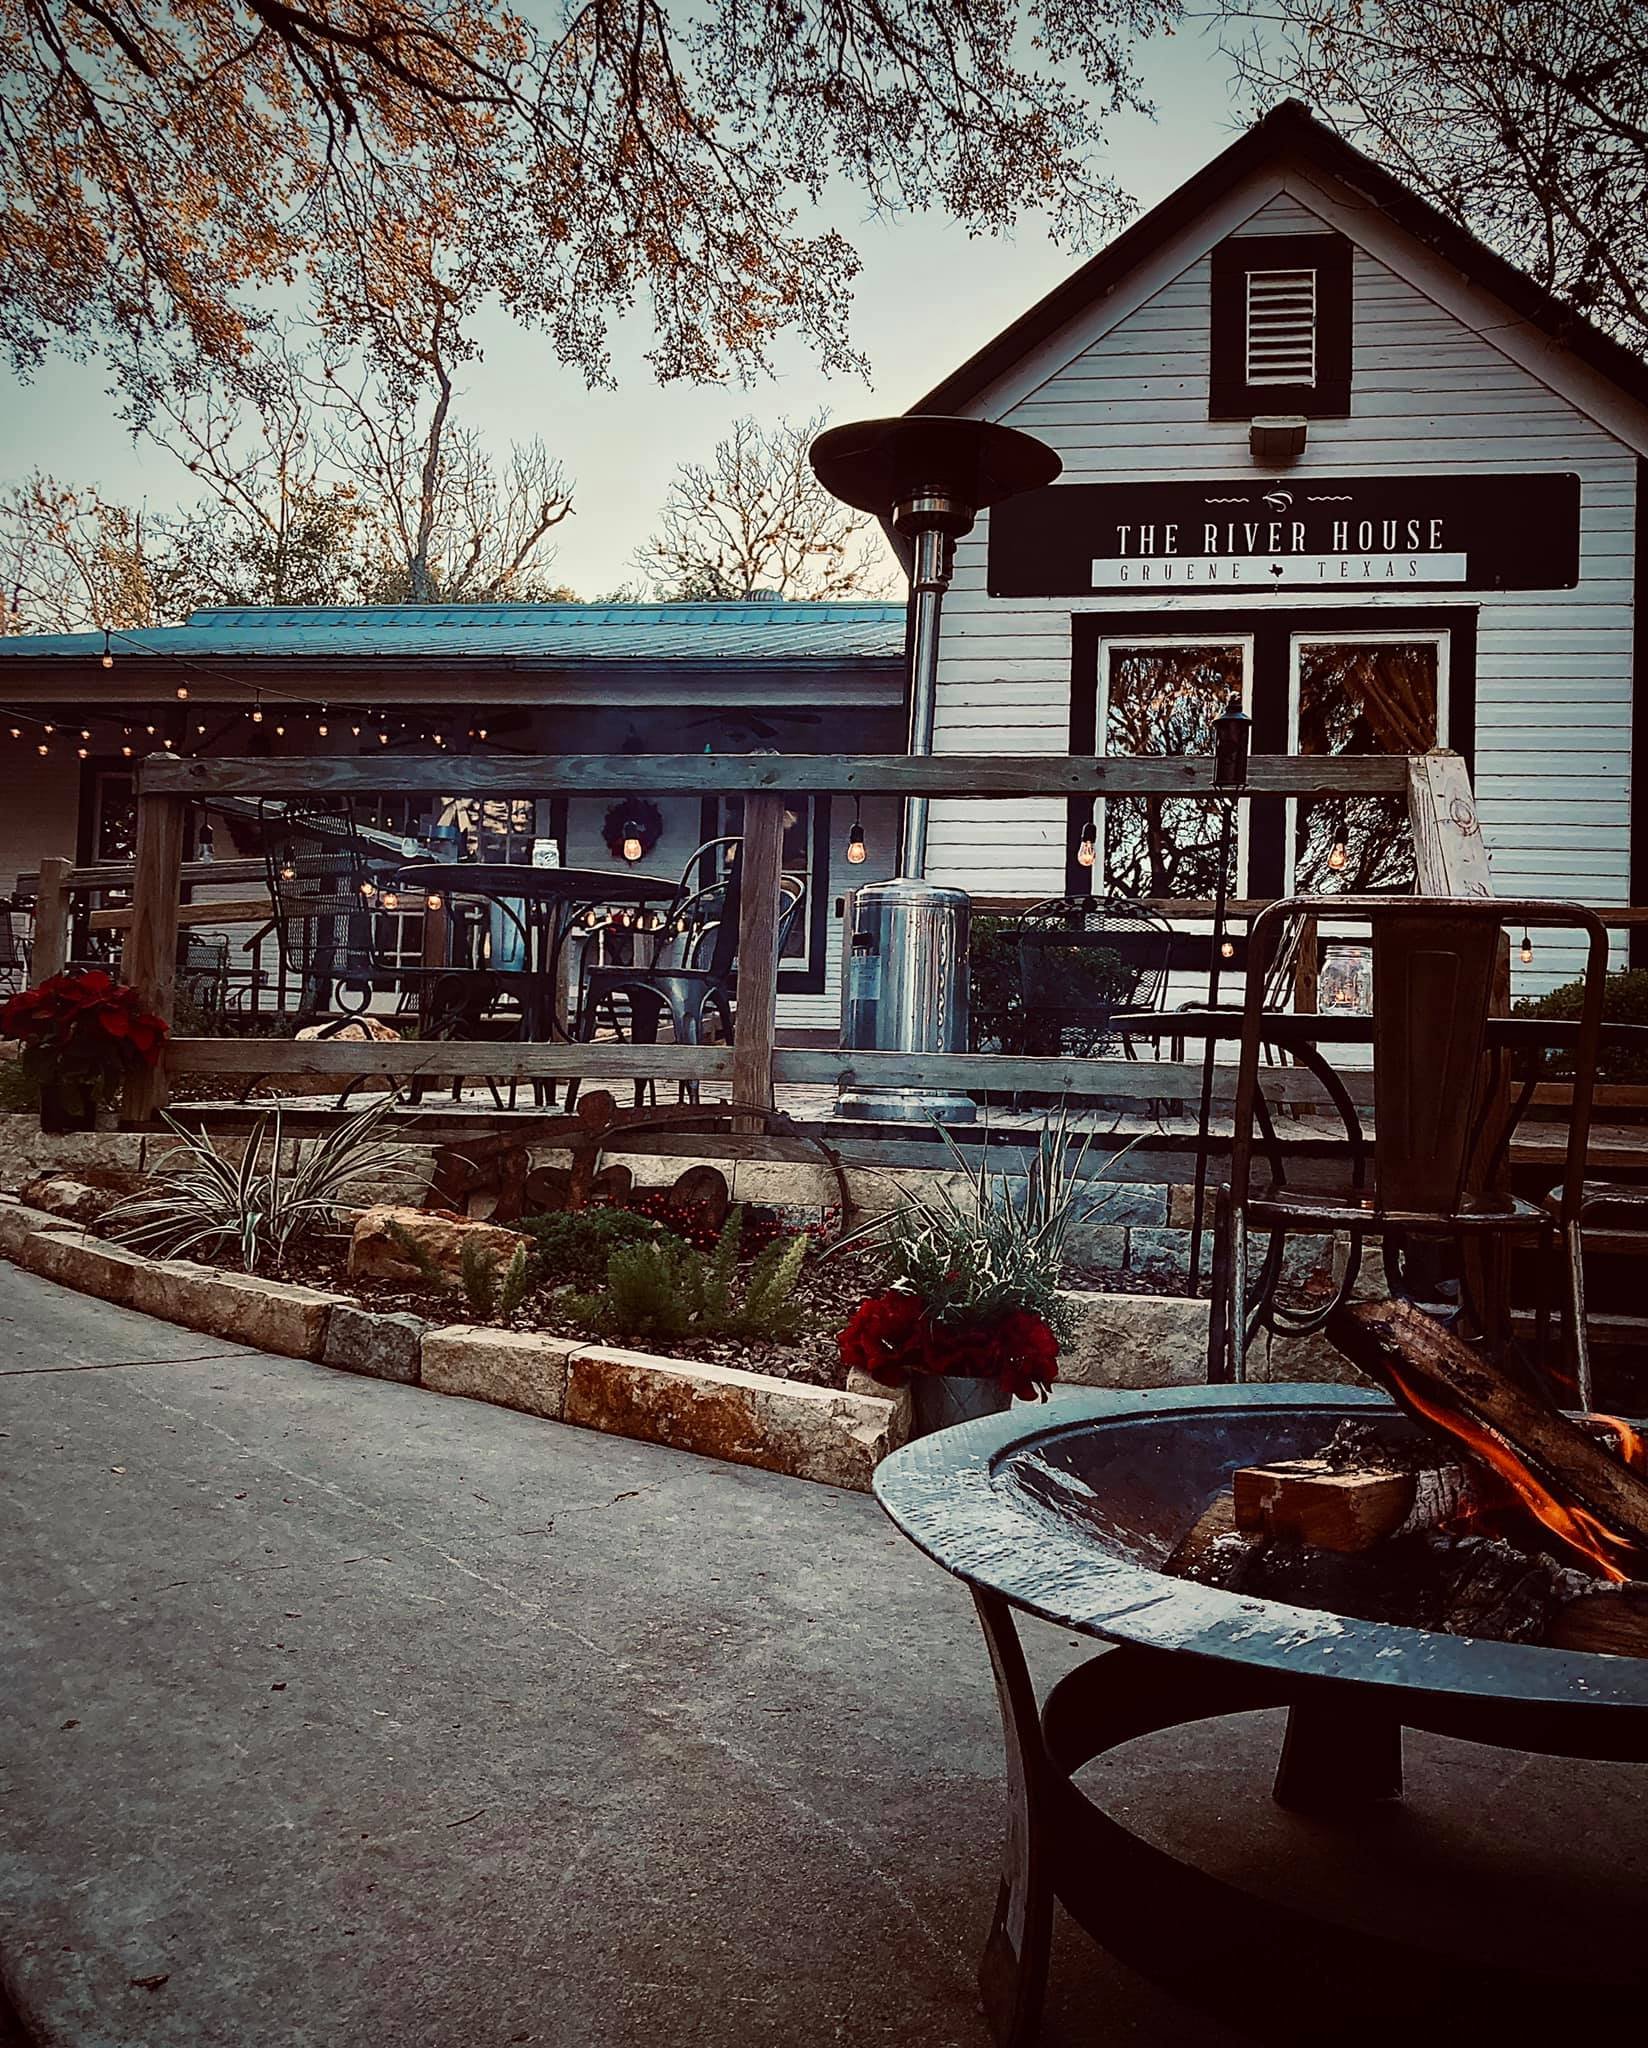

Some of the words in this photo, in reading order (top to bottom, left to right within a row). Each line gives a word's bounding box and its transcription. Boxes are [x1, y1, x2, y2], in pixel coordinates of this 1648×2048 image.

[1117, 524, 1178, 555] THE
[1203, 522, 1306, 553] RIVER
[1332, 519, 1443, 551] HOUSE
[1120, 563, 1240, 581] GRUENE
[1317, 560, 1417, 578] TEXAS
